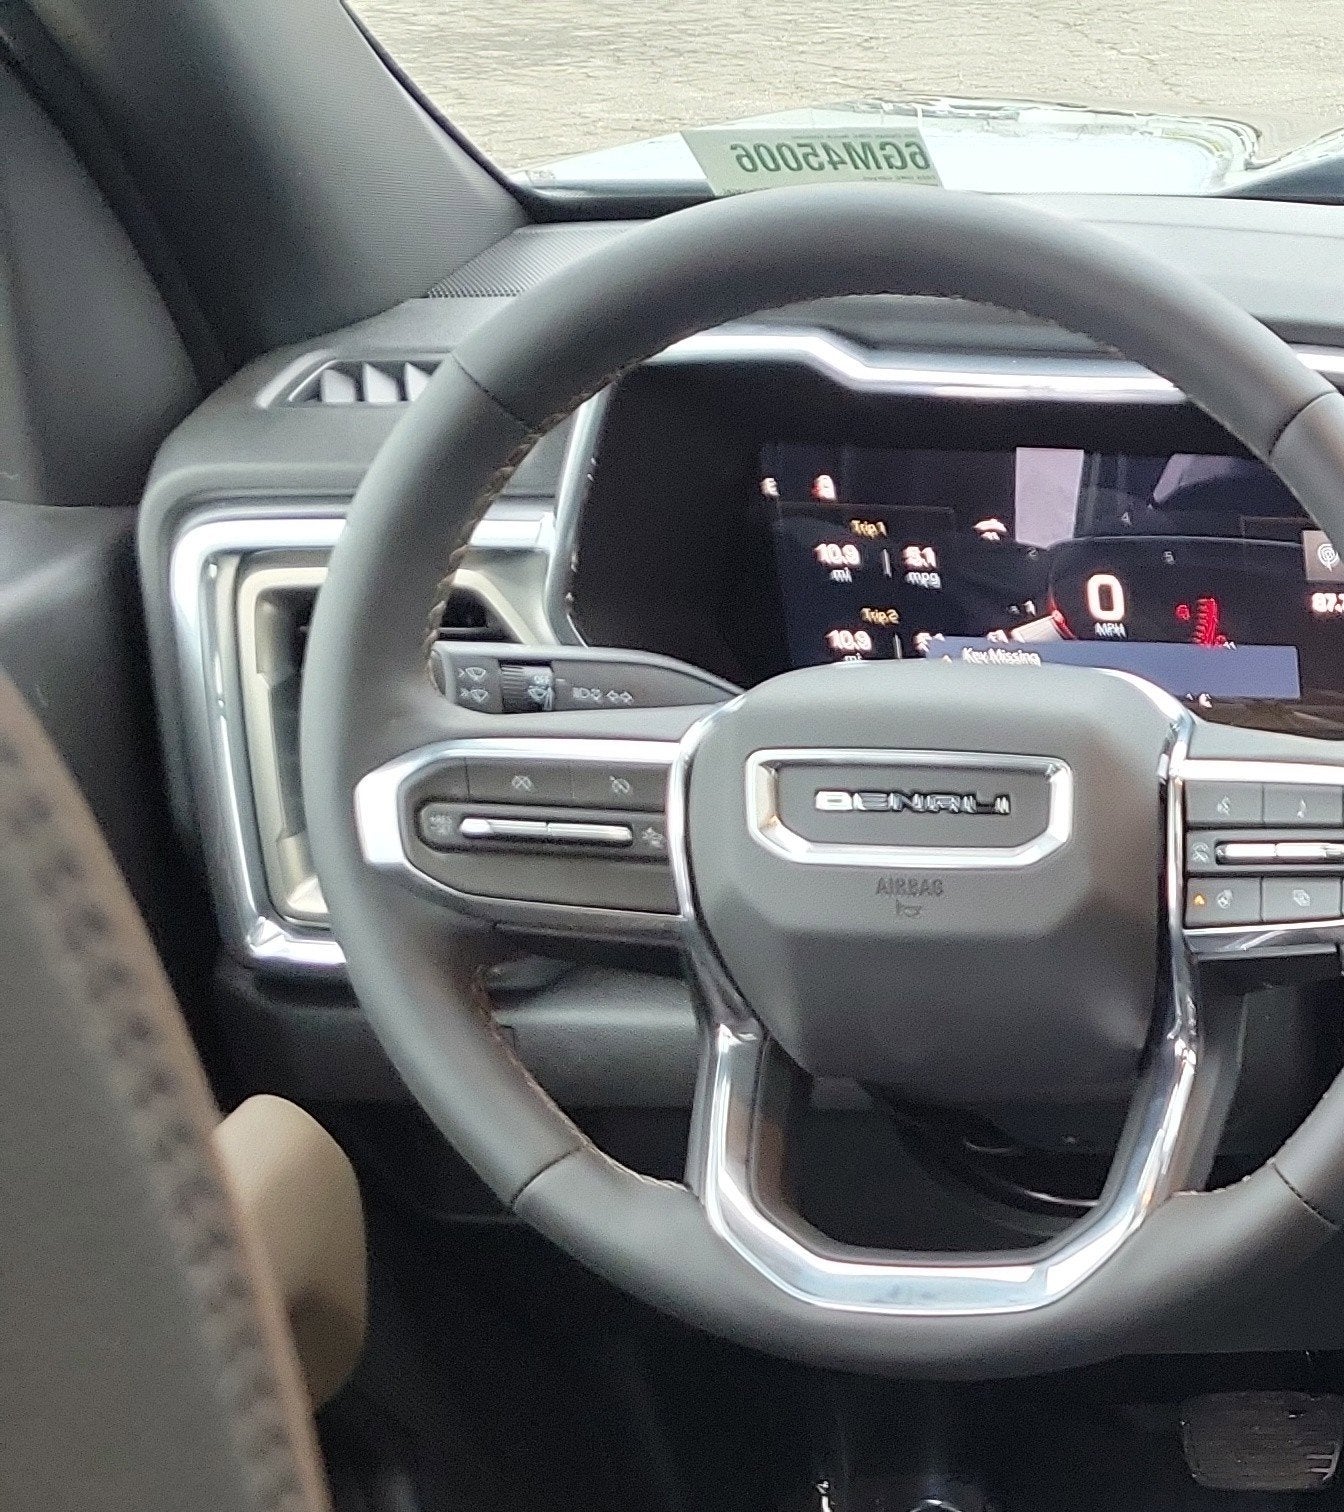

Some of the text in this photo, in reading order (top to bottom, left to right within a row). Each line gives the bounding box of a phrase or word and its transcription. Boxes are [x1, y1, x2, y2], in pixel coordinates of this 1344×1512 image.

[850, 519, 876, 538] Trip
[906, 571, 942, 590] mpg
[1087, 574, 1125, 621] 0
[861, 607, 887, 626] Trip
[1094, 623, 1127, 638] MPH
[962, 648, 1041, 666] Key Missing
[875, 876, 944, 897] AIRBAG
